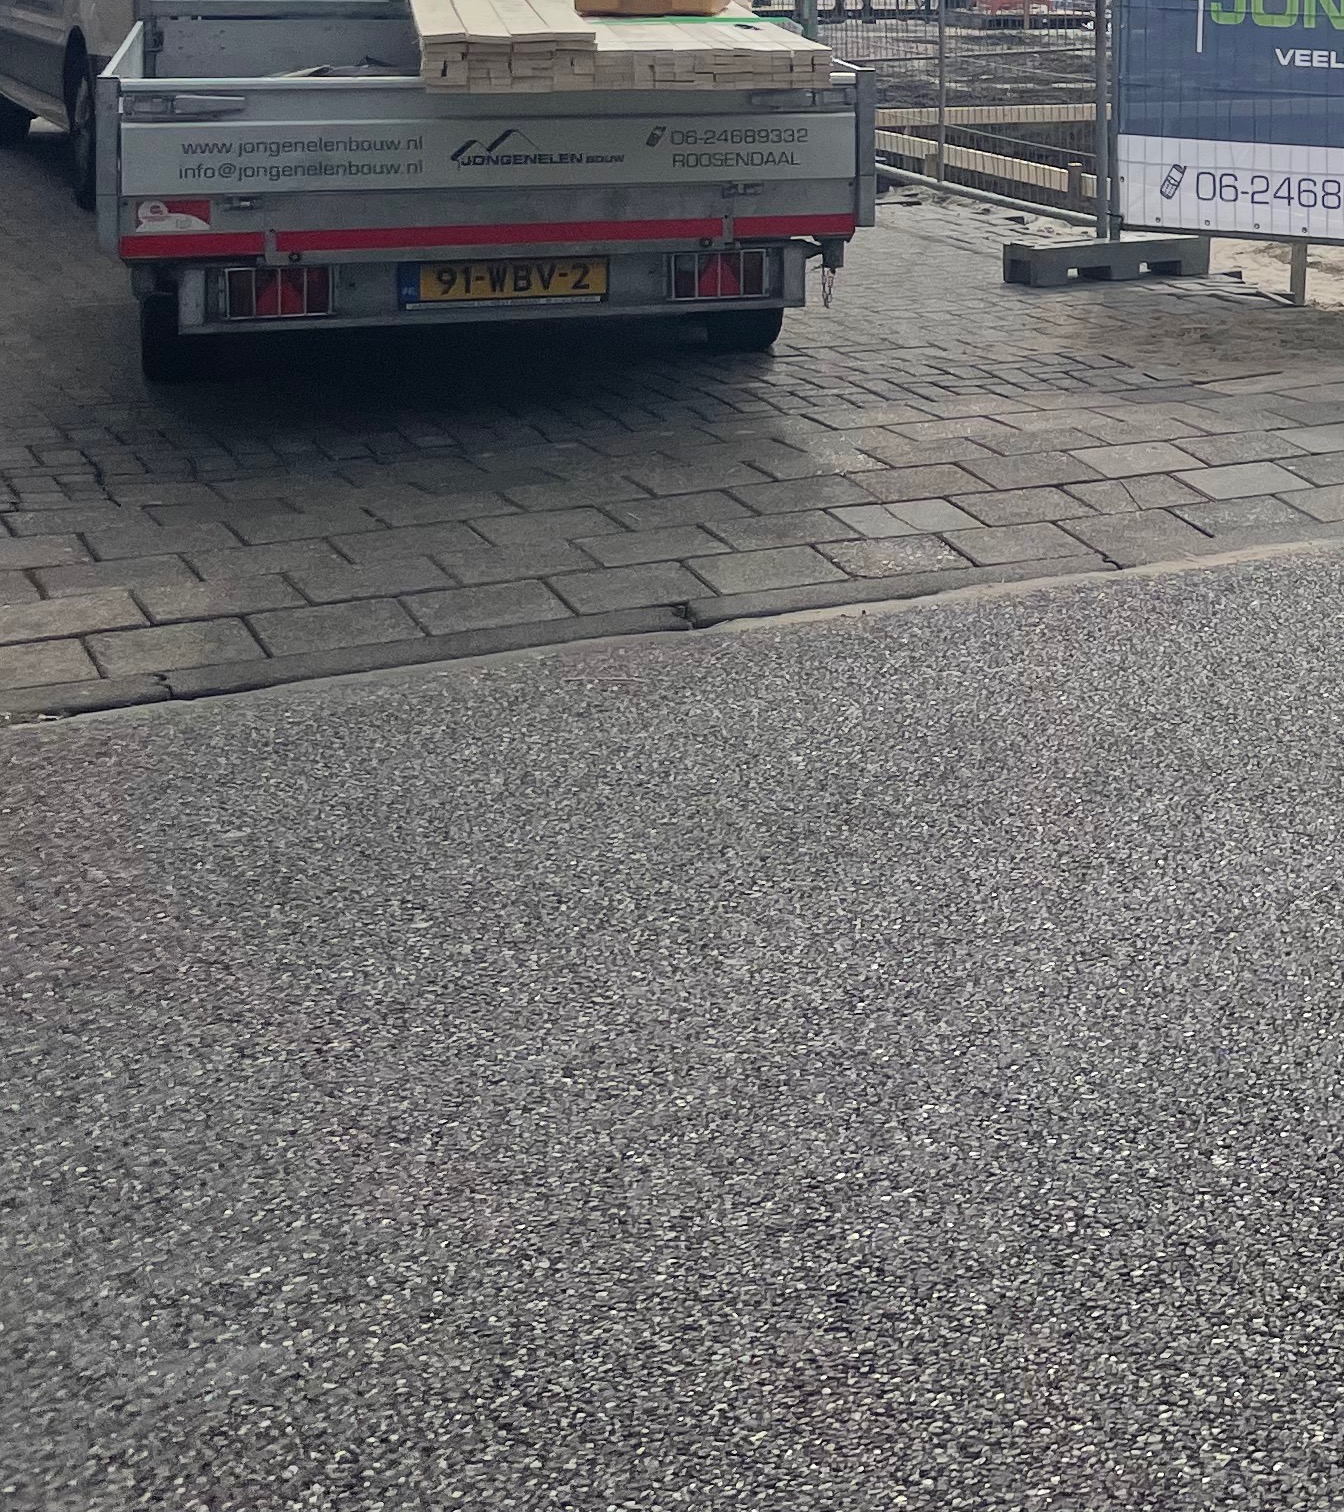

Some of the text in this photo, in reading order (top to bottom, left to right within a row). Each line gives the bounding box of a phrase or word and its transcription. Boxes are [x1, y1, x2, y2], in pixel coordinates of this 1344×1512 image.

[670, 128, 809, 145] 06-24689332
[181, 136, 423, 158] www.jongenelenbouw.nl
[460, 153, 625, 167] JONGENELEN BOUW
[672, 151, 801, 168] ROOSENDAAL
[179, 160, 423, 182] info@jongenelenbouw.nl
[434, 262, 590, 296] 91-WBV-2
